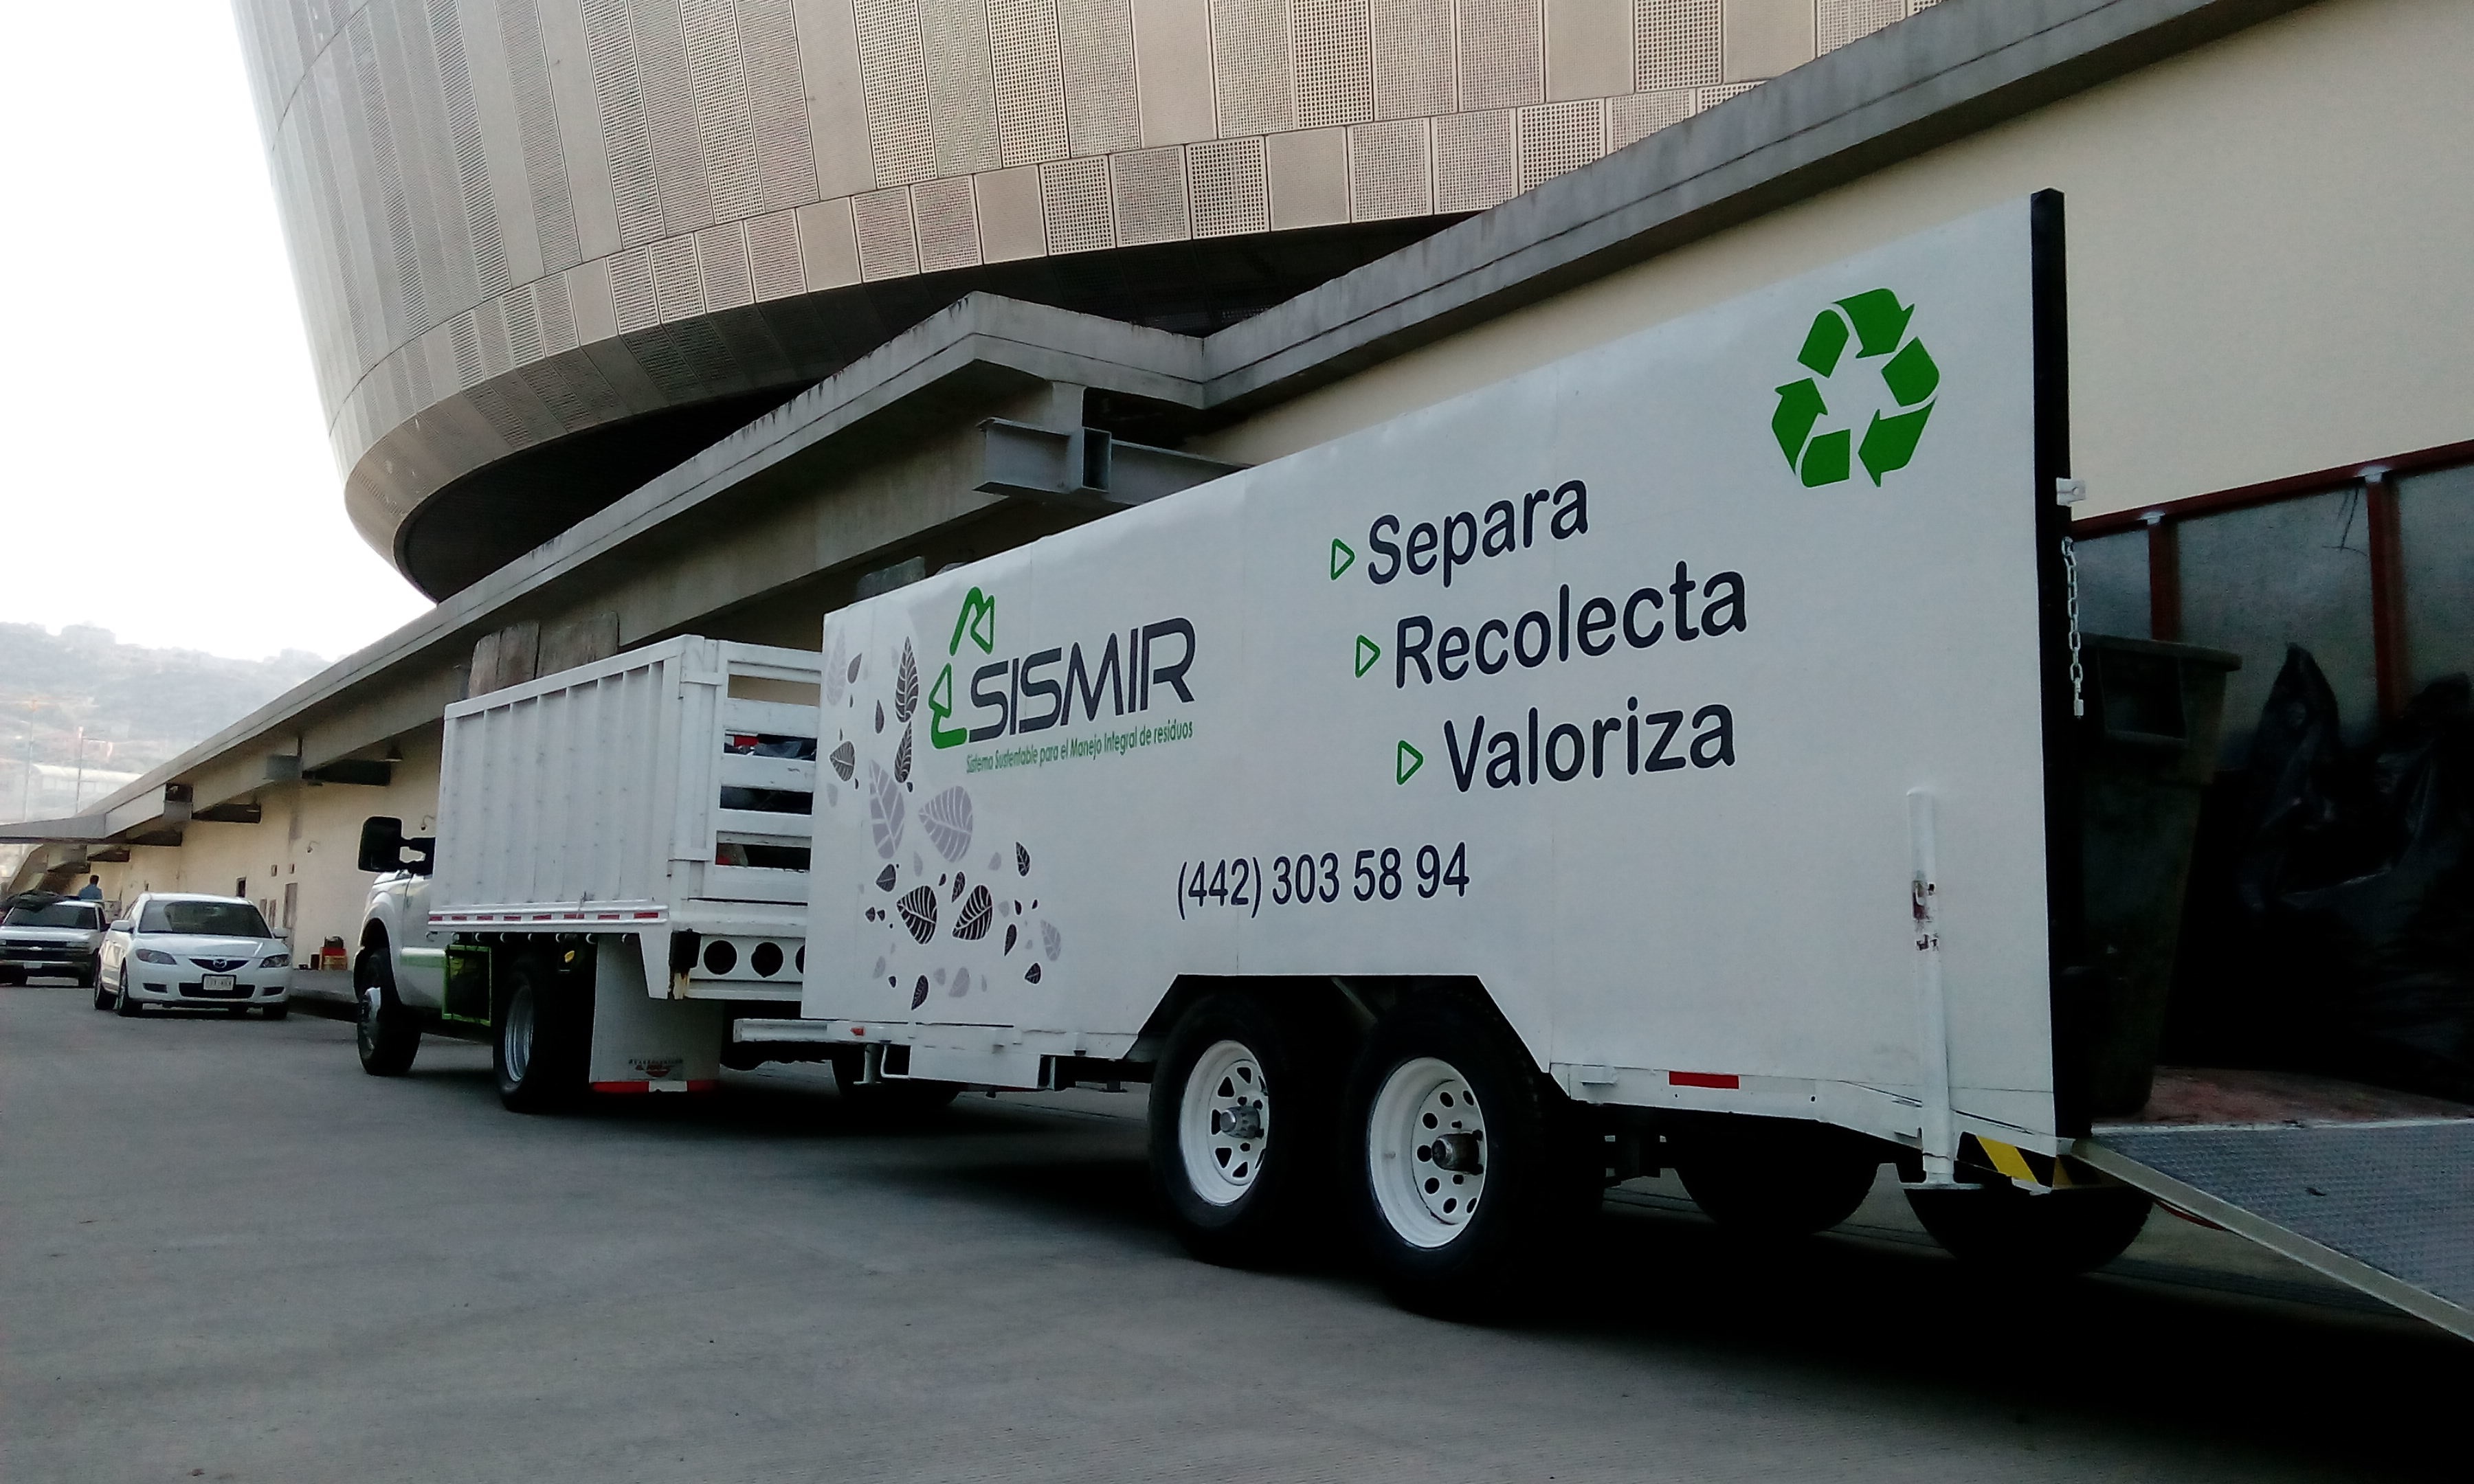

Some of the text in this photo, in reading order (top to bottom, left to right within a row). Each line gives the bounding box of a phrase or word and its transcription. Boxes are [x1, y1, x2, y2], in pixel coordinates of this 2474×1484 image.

[1368, 480, 1588, 588] Separa
[1396, 561, 1746, 688] Recolecta
[968, 617, 1195, 743] SISMIR
[966, 719, 1193, 774] Sistema Sustentable para el Manejo Integral de residuos
[1444, 696, 1735, 793] Valoriza
[1177, 841, 1470, 920] (442) 303 58 94
